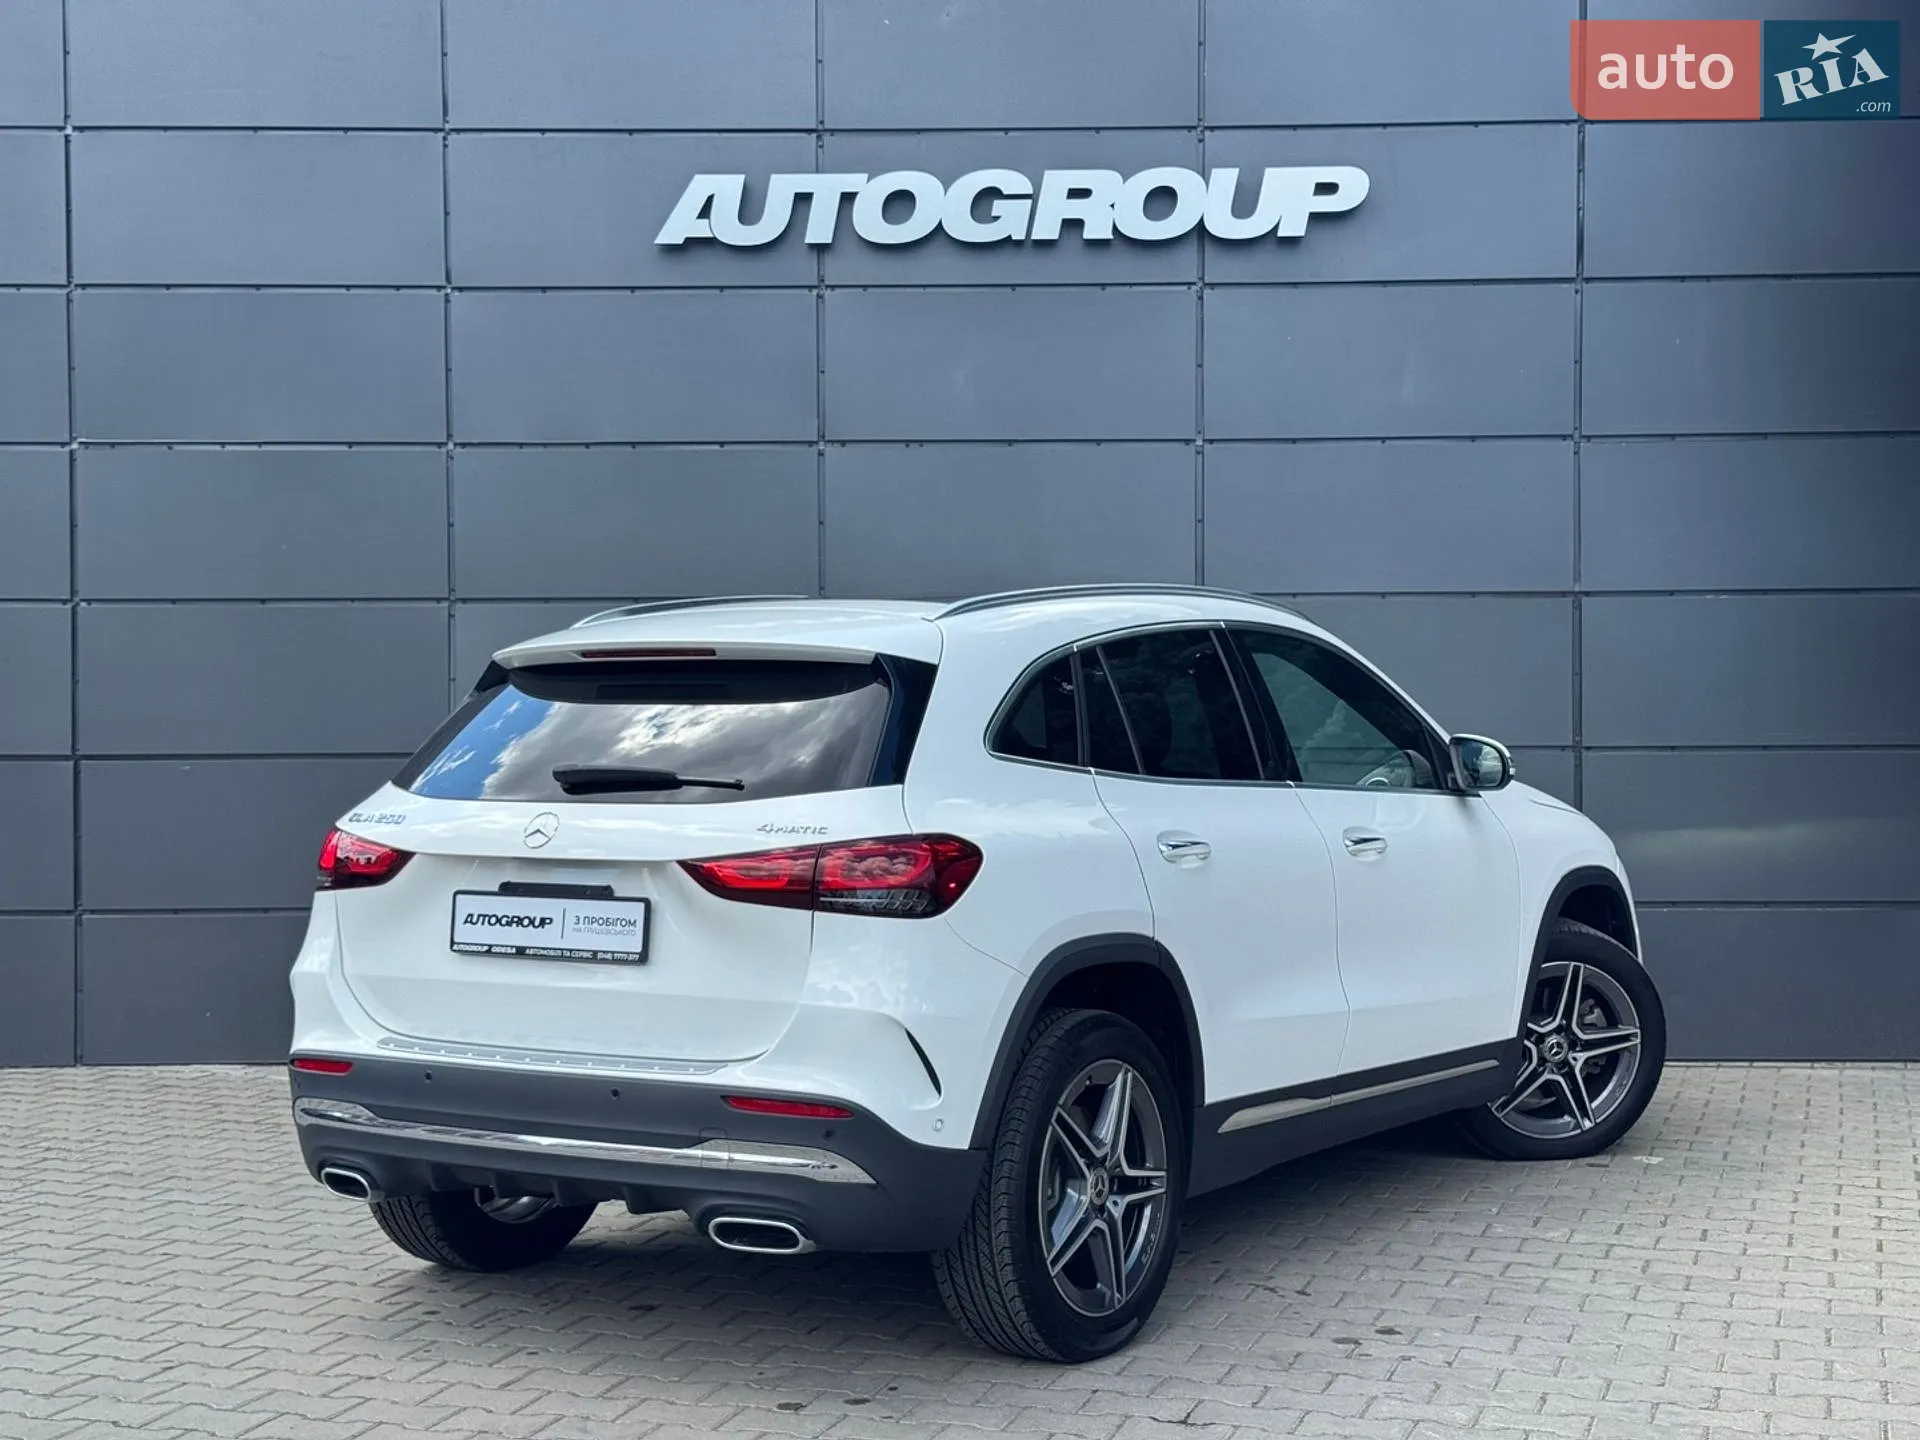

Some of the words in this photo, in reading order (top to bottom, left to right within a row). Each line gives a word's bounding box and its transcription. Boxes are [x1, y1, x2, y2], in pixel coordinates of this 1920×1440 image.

[654, 165, 1371, 246] AUTOGROUP
[348, 812, 375, 823] GLA
[375, 813, 407, 825] 250
[756, 822, 829, 834] 4MATIC
[463, 912, 554, 929] AUTOGROUP
[582, 915, 637, 928] ПРОБІГОМ
